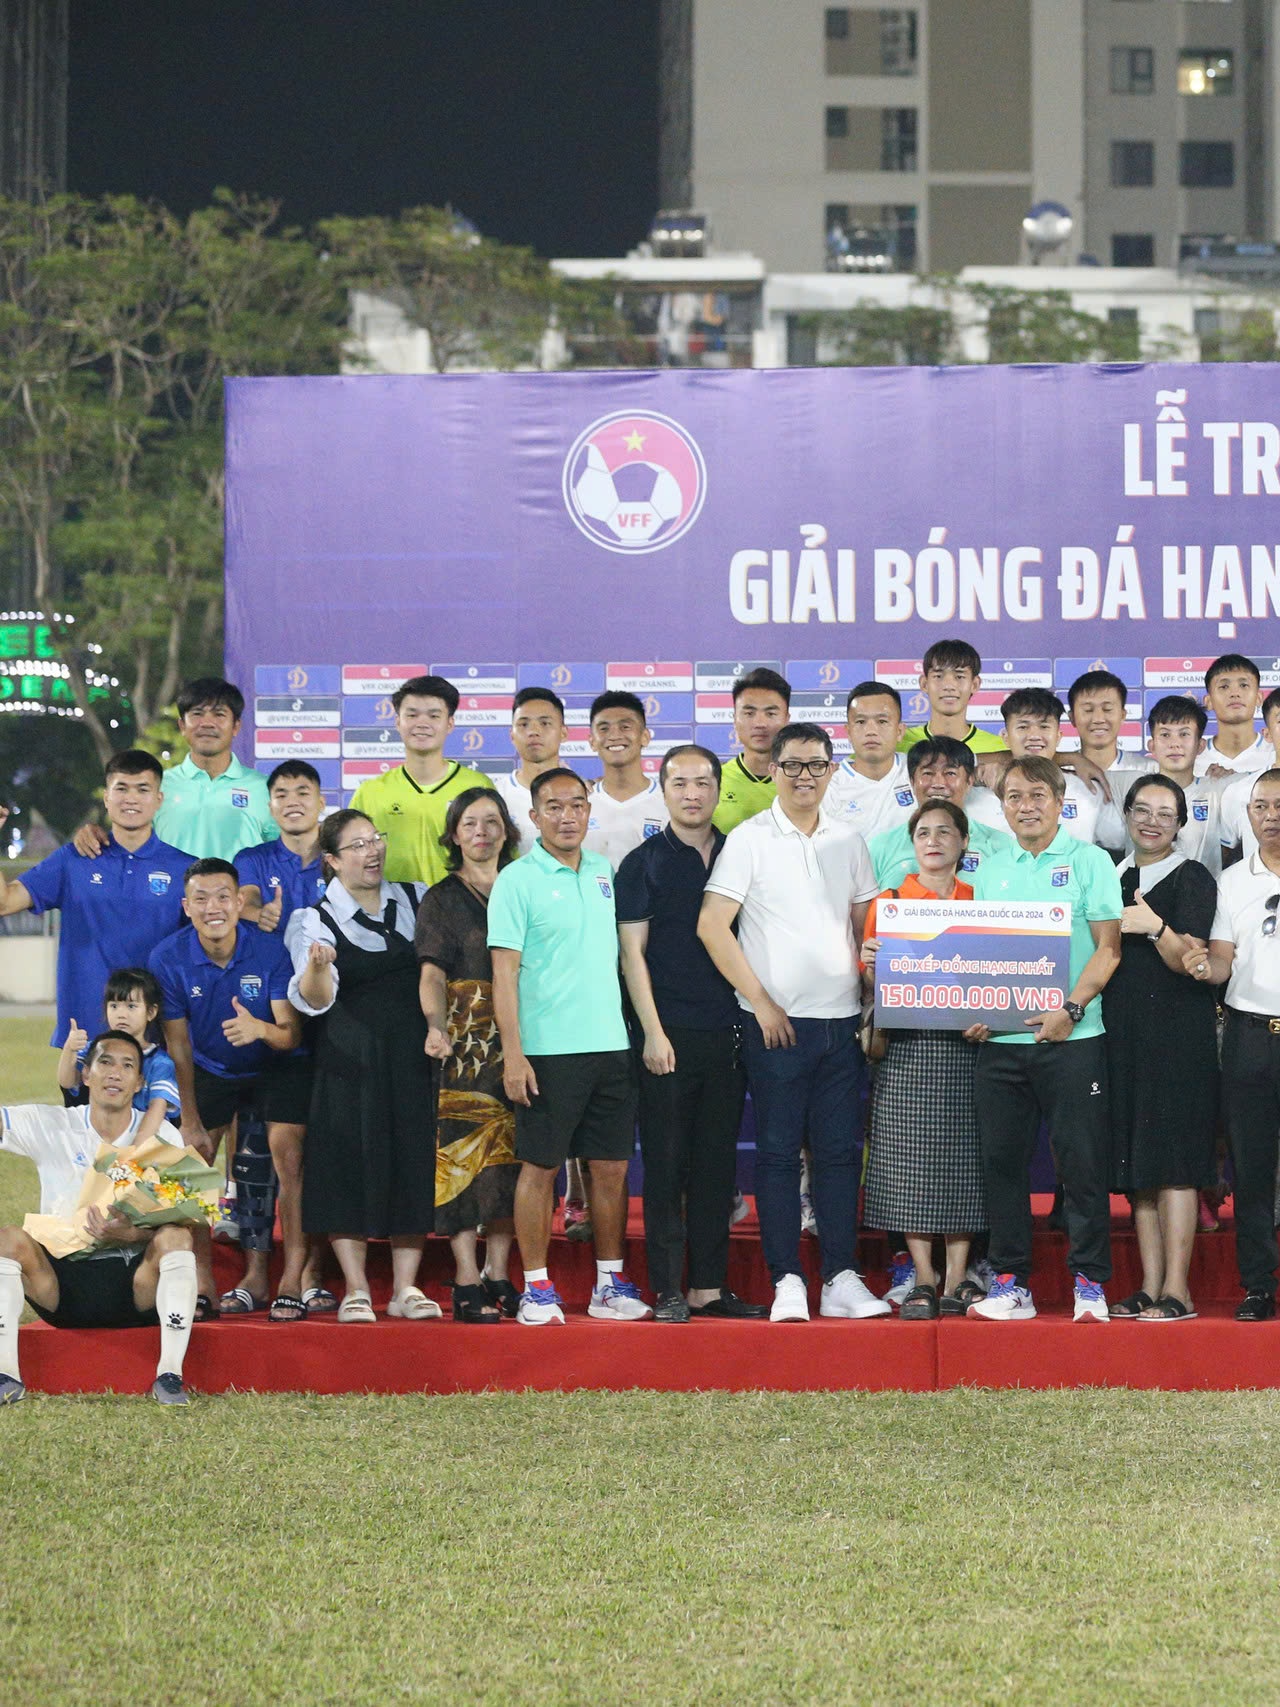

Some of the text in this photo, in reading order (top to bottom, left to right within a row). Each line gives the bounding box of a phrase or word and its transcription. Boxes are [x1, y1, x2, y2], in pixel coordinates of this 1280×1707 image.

[1124, 388, 1188, 497] LỄ
[617, 512, 652, 529] VFF
[729, 523, 857, 626] GIẢI
[874, 526, 1043, 623] BÓNG
[1057, 525, 1146, 621] ĐÁ
[639, 680, 677, 688] CHANNEL
[1177, 675, 1205, 683] CHANN
[798, 710, 847, 719] @VFF.OFFIC
[890, 954, 1056, 976] ĐỘI XẾP ĐỒNG HẠNG NHẤT
[880, 984, 1064, 1011] 150.000.000 VNĐ
